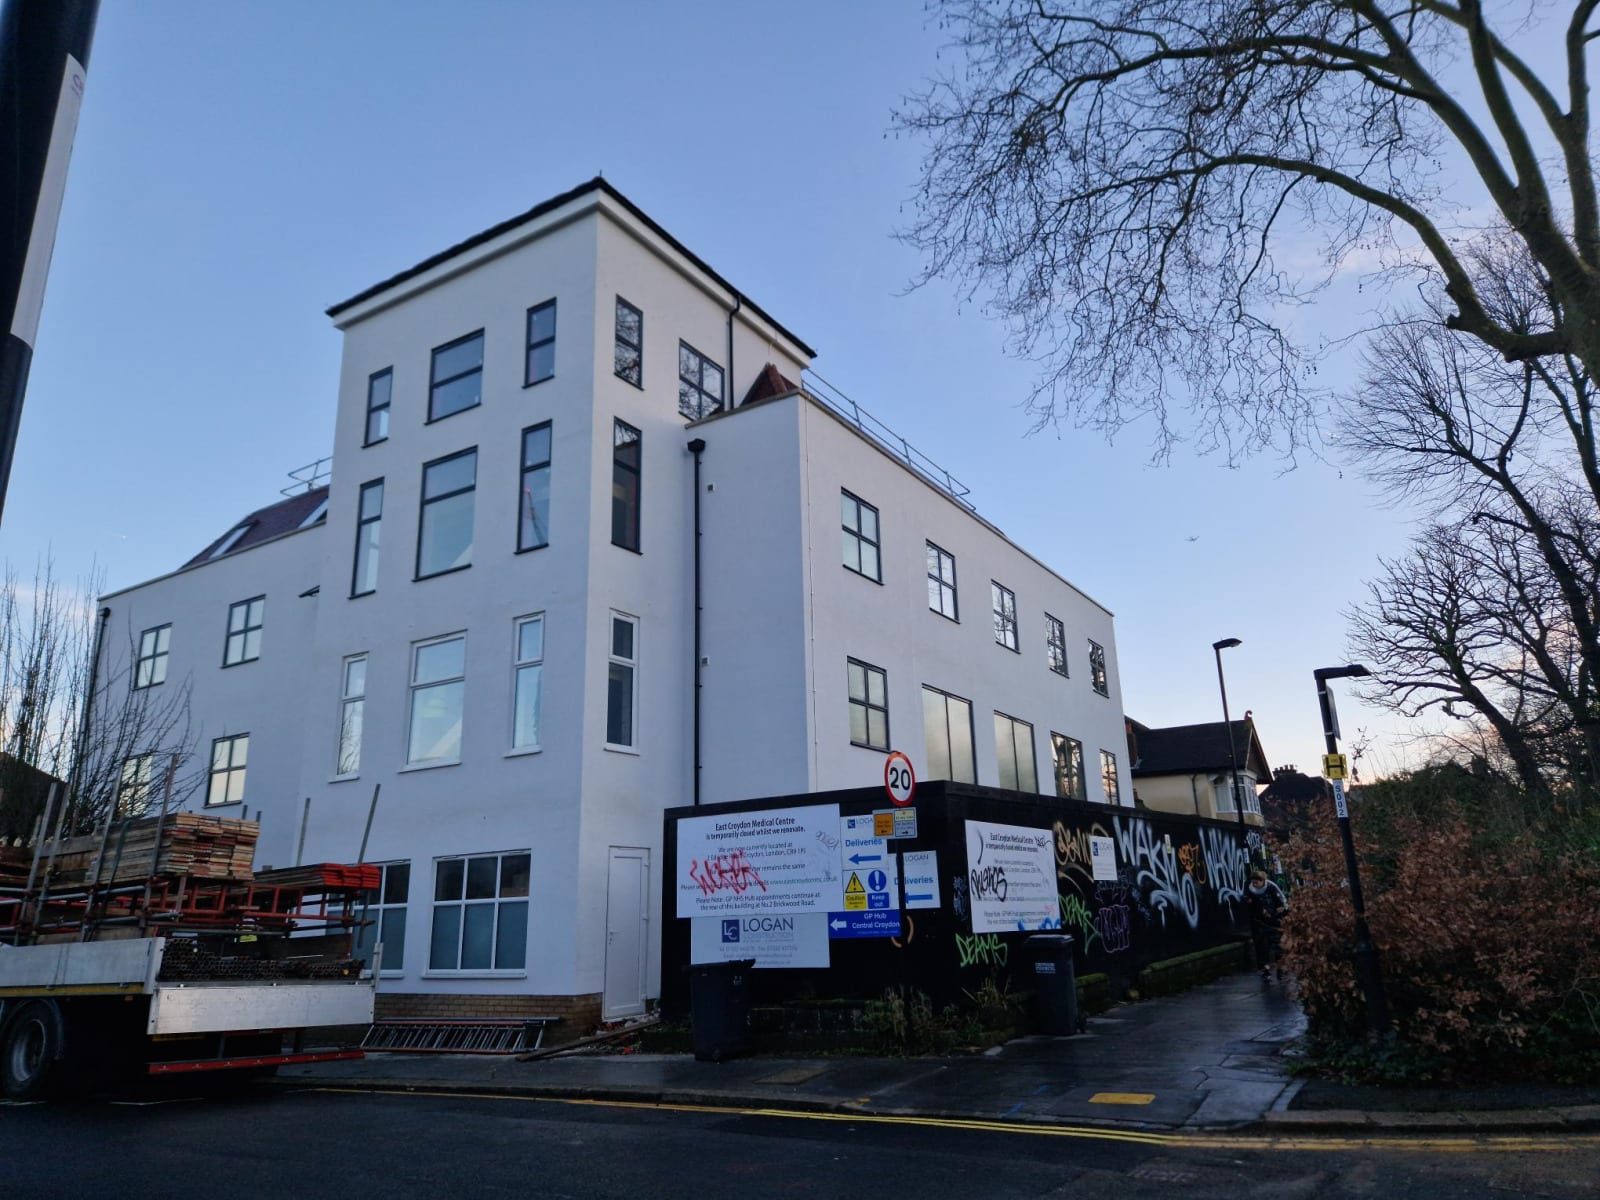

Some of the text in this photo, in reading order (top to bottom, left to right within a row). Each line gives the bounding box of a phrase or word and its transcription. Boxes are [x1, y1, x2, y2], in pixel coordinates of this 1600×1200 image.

[889, 766, 911, 791] 20
[1334, 785, 1345, 816] S002
[715, 817, 796, 831] East Croydon Medical Centre
[856, 817, 873, 826] LOGA
[740, 829, 755, 837] closed
[756, 828, 772, 836] whilst
[845, 838, 882, 848] Deliveries
[904, 854, 929, 863] LOGAN
[894, 876, 934, 886] Dliveries
[874, 912, 887, 920] Hub
[742, 917, 794, 932] LOGAN
[852, 921, 901, 929] Central Croydon
